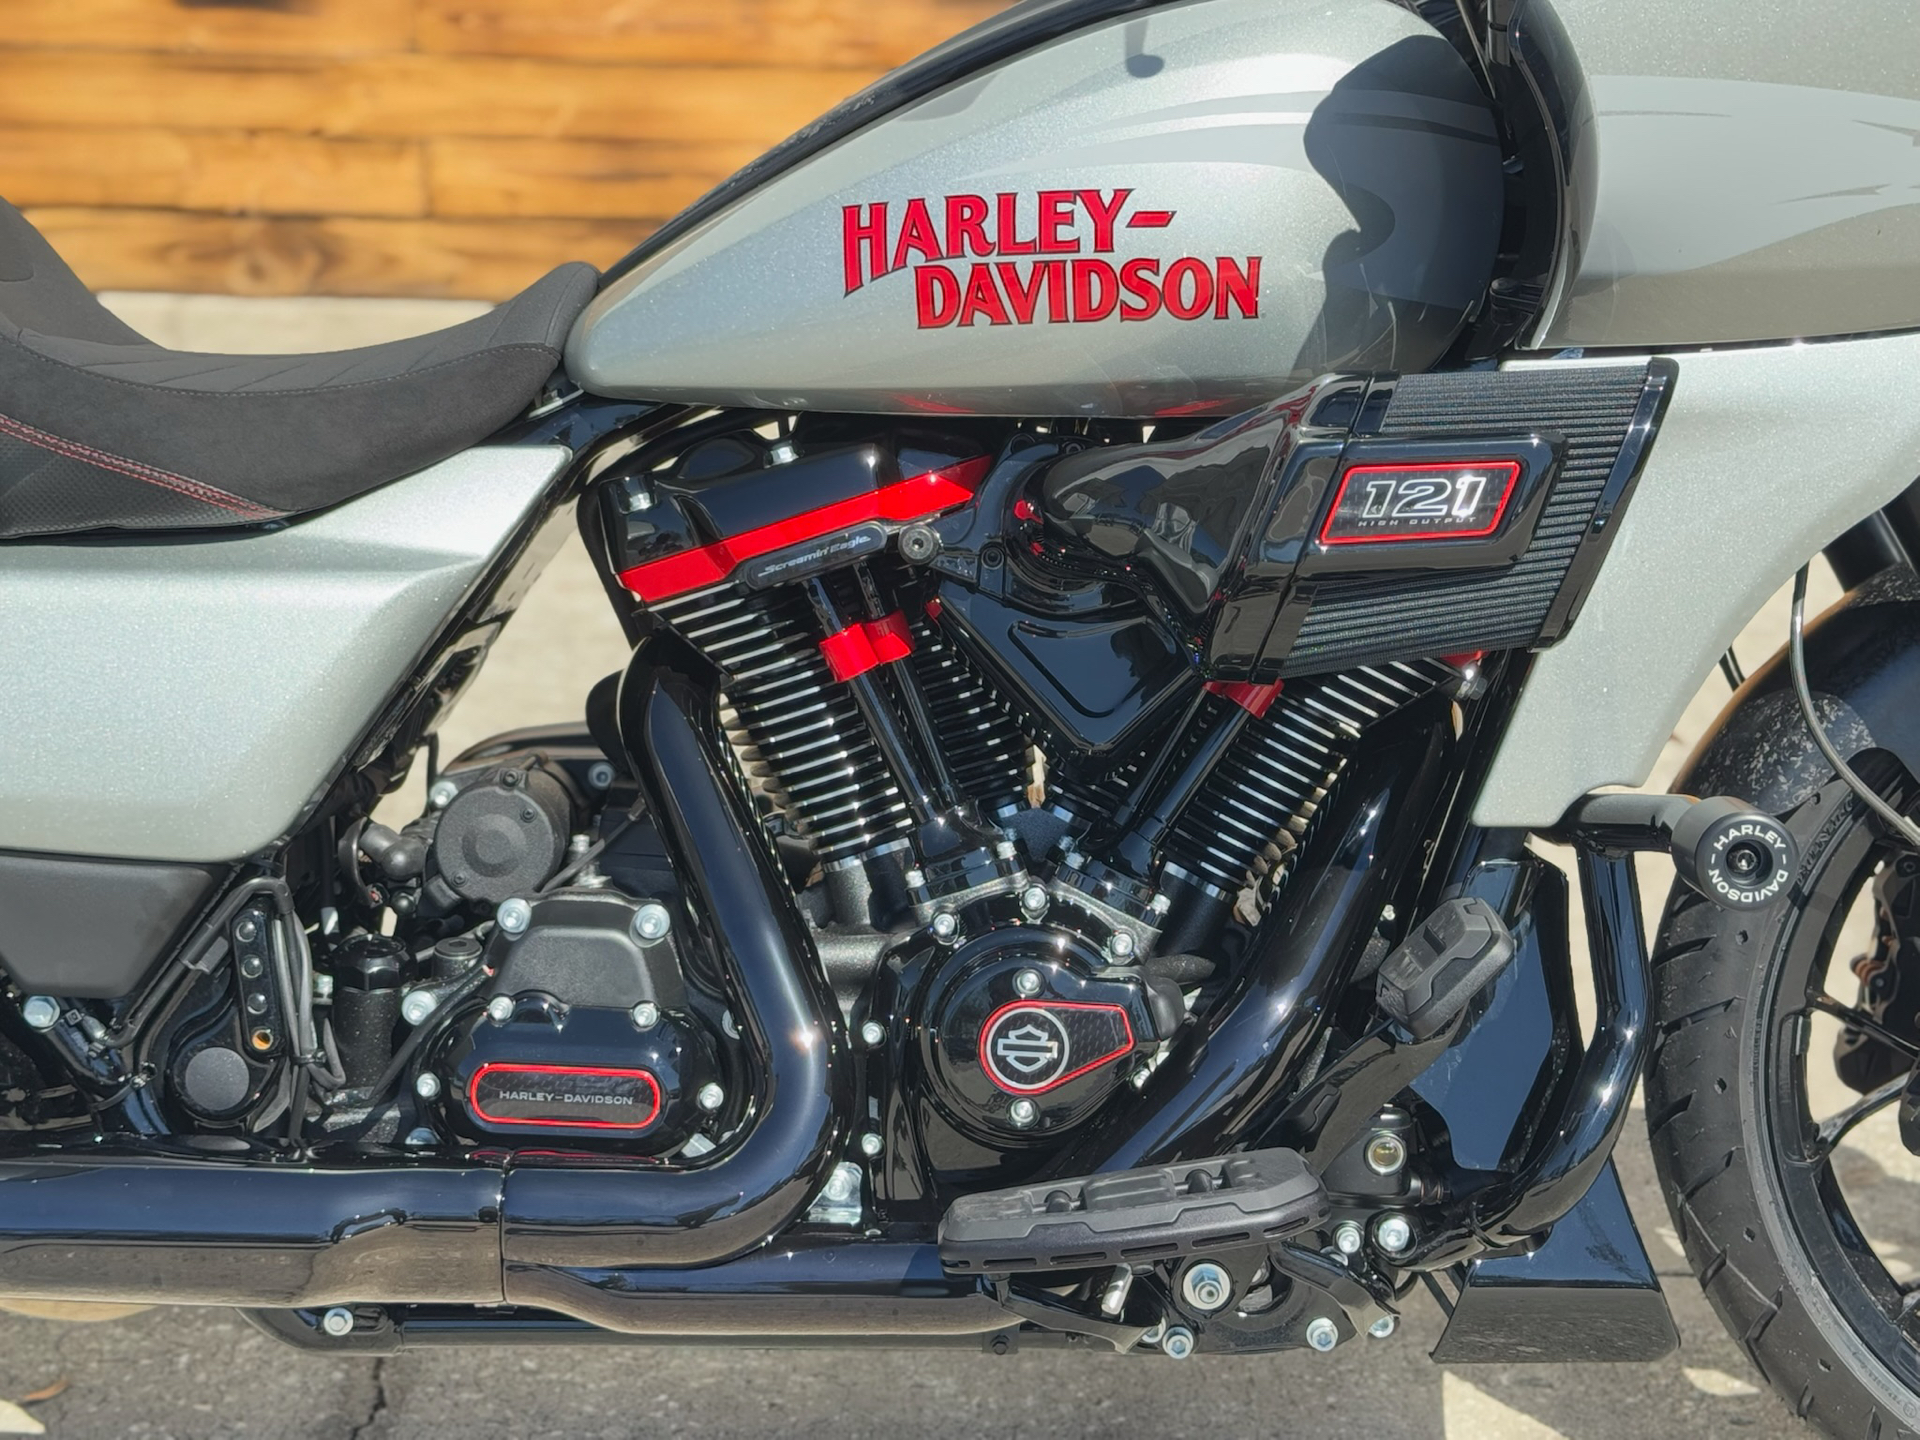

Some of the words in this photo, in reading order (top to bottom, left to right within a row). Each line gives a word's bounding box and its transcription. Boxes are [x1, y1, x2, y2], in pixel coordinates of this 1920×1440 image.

[842, 188, 1177, 298] HARLEY-
[914, 256, 1262, 329] DAVIDSON
[1362, 476, 1487, 518] 121
[1359, 519, 1399, 527] HIGH
[1409, 517, 1476, 525] OUTPUT
[830, 535, 872, 554] Eagle
[1713, 824, 1786, 851] HARLEY
[1708, 869, 1789, 903] DAVIDSON
[500, 1090, 633, 1105] HARLEY-DAVIDSON
